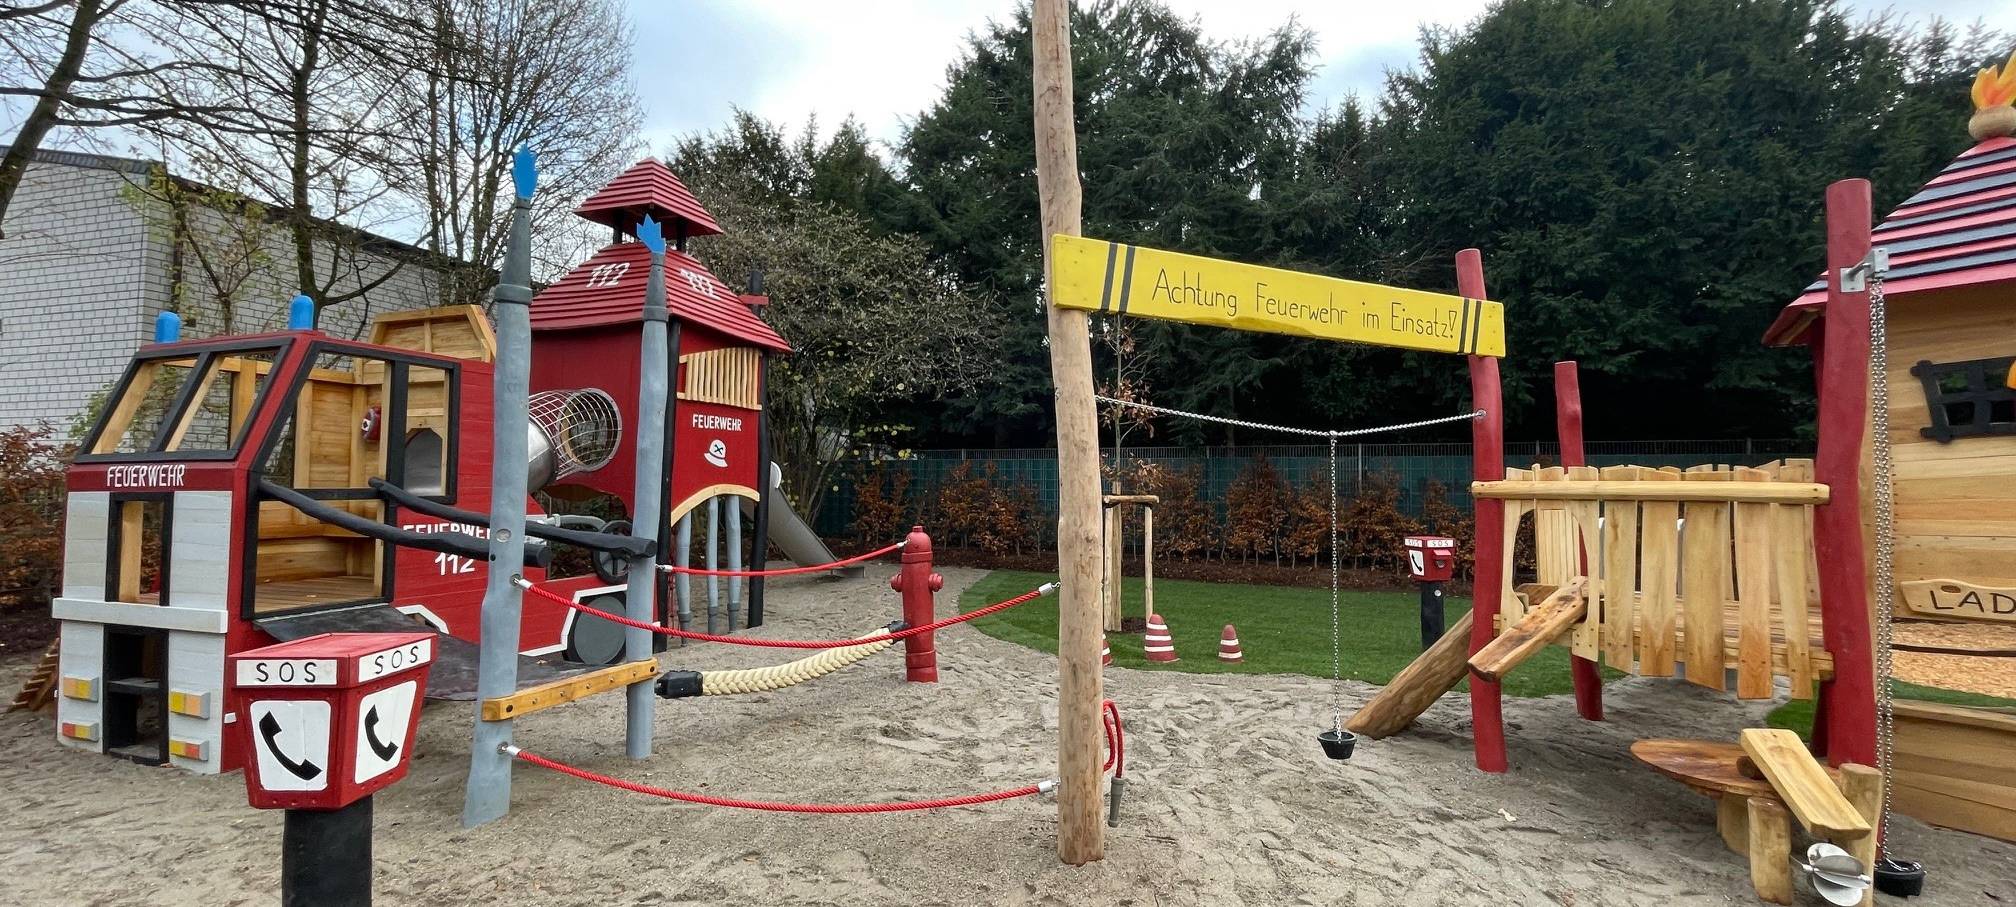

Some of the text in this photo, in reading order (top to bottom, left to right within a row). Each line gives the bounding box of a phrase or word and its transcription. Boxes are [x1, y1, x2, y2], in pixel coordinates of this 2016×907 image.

[586, 262, 630, 287] 112
[1151, 267, 1458, 339] Achtung Feuerwehr im Einsatz!
[692, 413, 742, 432] FEUERWEHR
[106, 463, 185, 488] FEUERWEHR
[434, 552, 475, 576] 112
[256, 662, 317, 683] SOS
[374, 645, 419, 675] SOS
